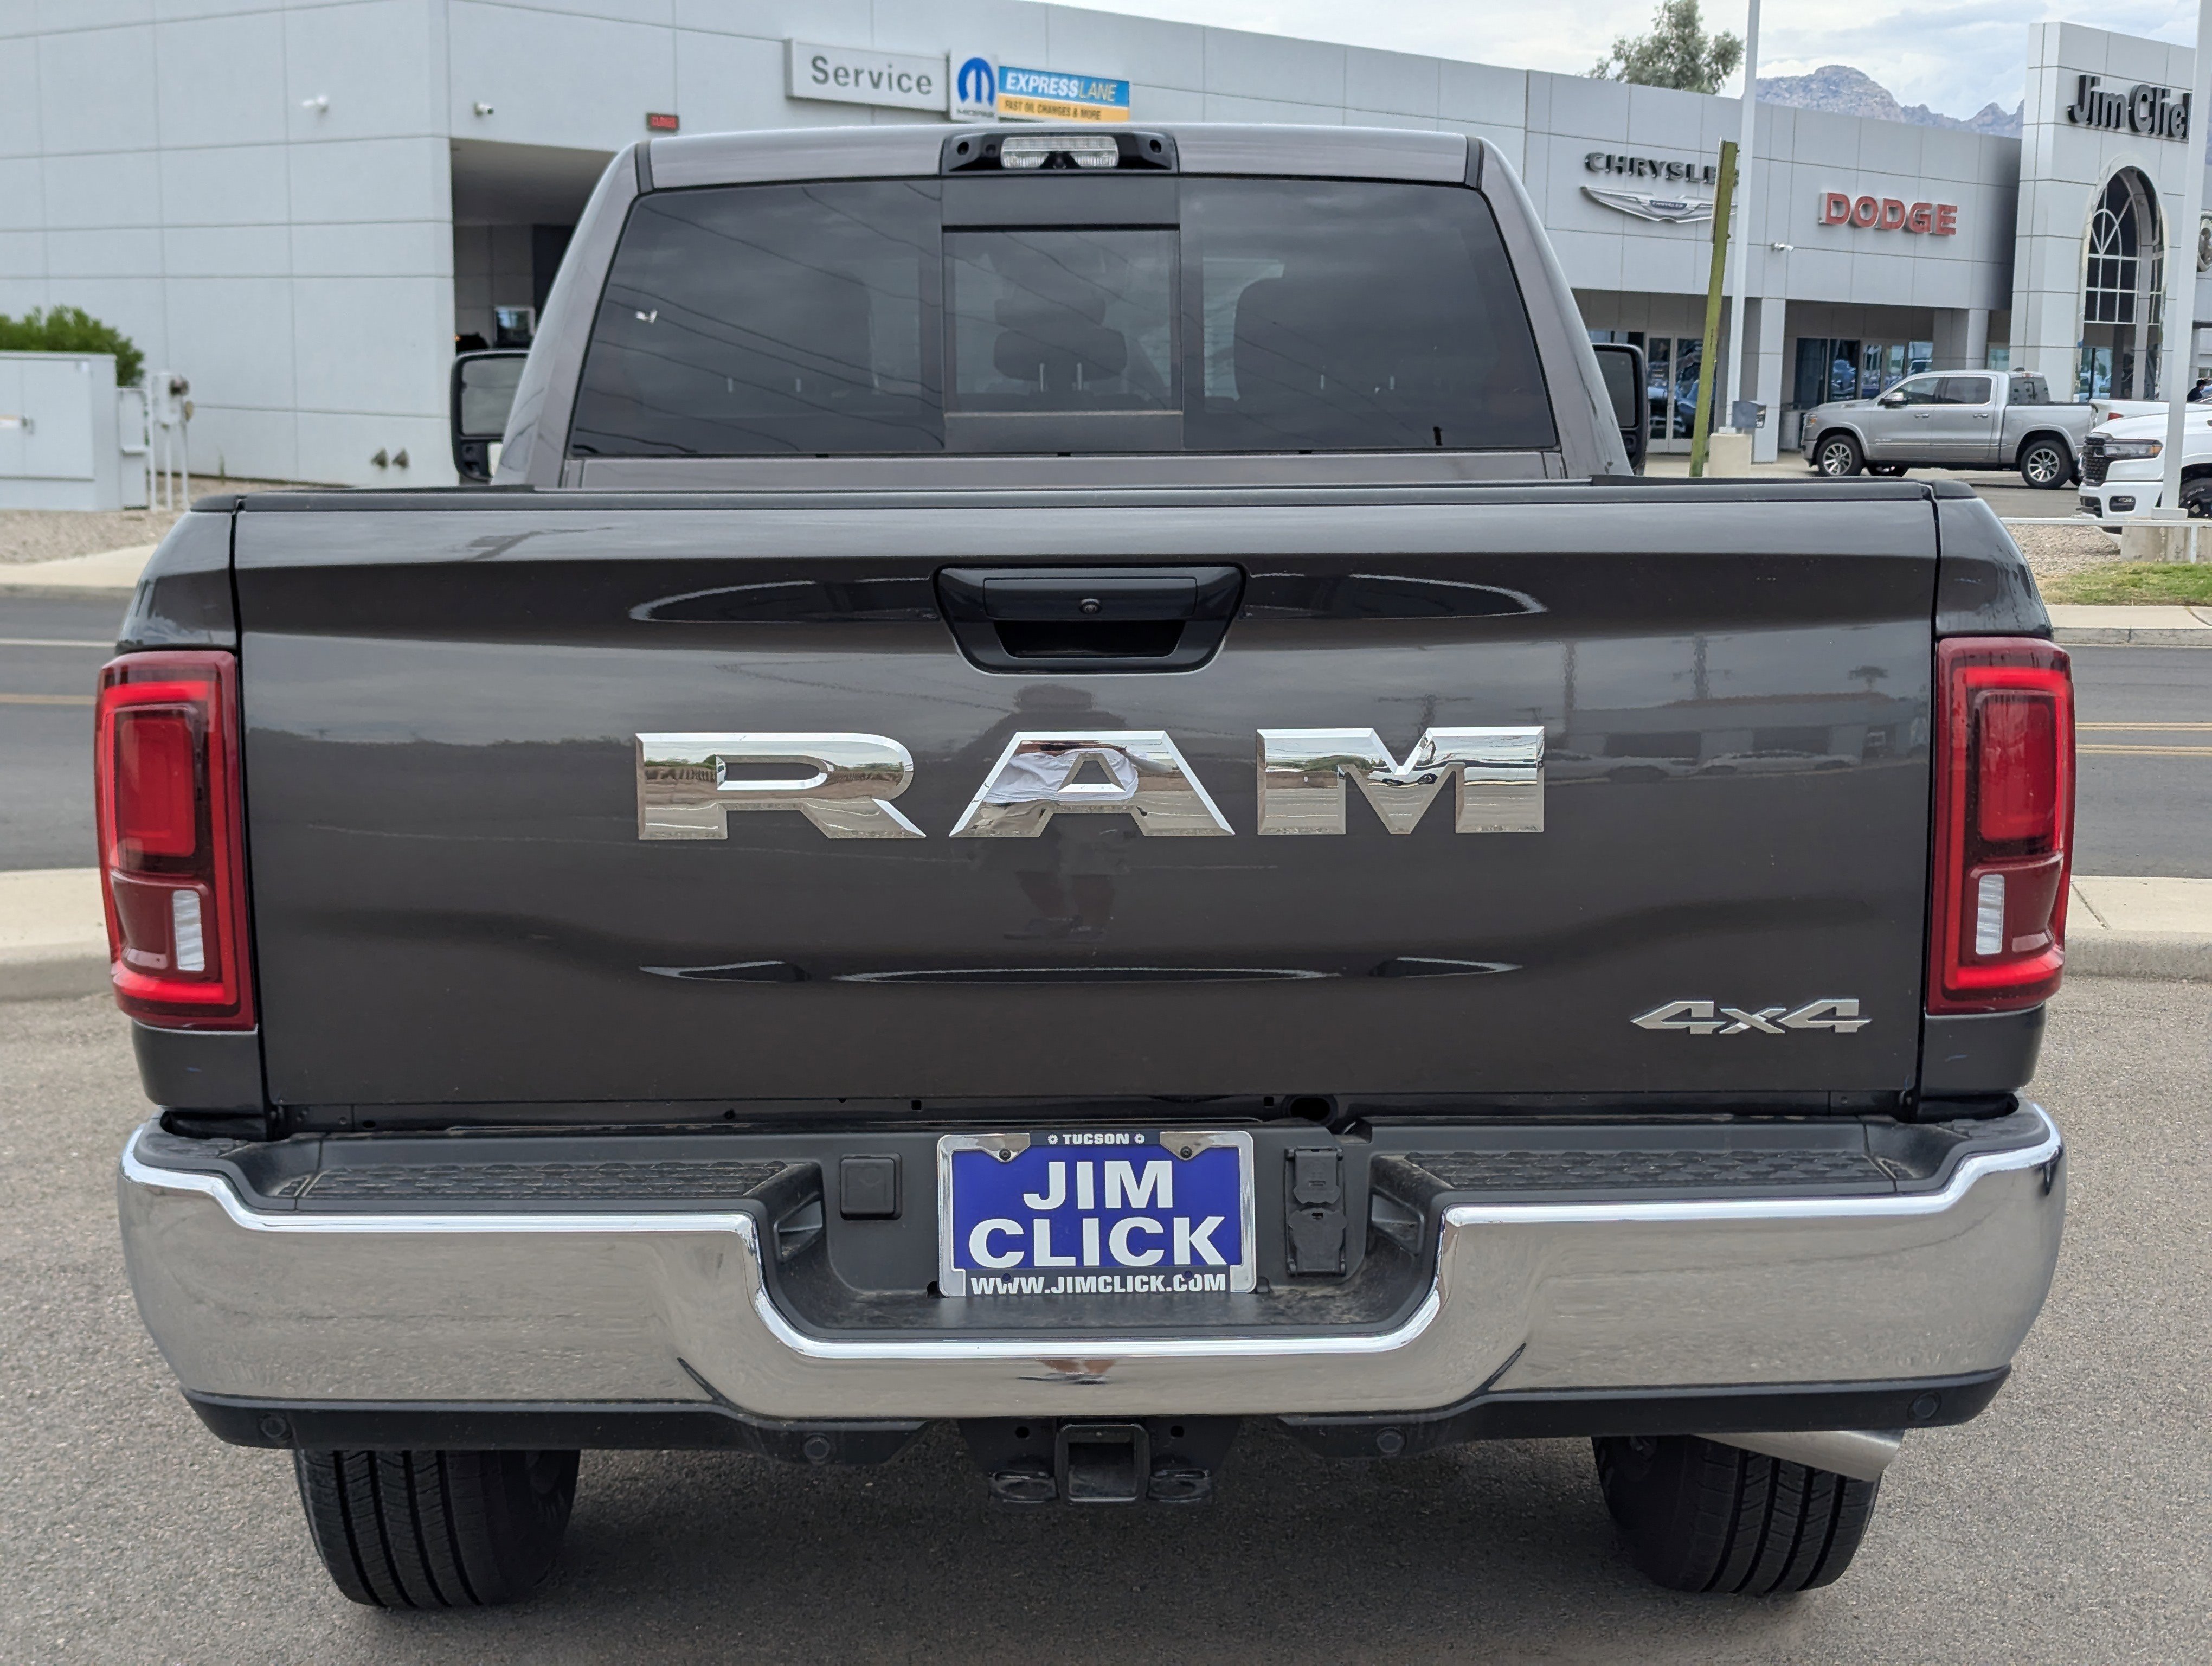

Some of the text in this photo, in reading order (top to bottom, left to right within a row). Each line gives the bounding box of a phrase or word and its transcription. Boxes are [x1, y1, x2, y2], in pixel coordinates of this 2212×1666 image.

[811, 55, 933, 94] Service
[1006, 72, 1117, 102] EXPRESSLANE
[1005, 100, 1023, 111] FAST
[1037, 104, 1070, 117] CHANGES
[1081, 109, 1101, 120] MORE
[2067, 75, 2127, 129] Jim
[1818, 192, 1958, 235] DODGE
[635, 726, 1546, 840] RAM
[1630, 998, 1872, 1034] 4x4
[1063, 1133, 1130, 1145] TUCSON
[1023, 1160, 1173, 1210] JIM
[969, 1216, 1227, 1269] CLICK
[971, 1273, 1226, 1295] WWW.JIMCLICK.COM
